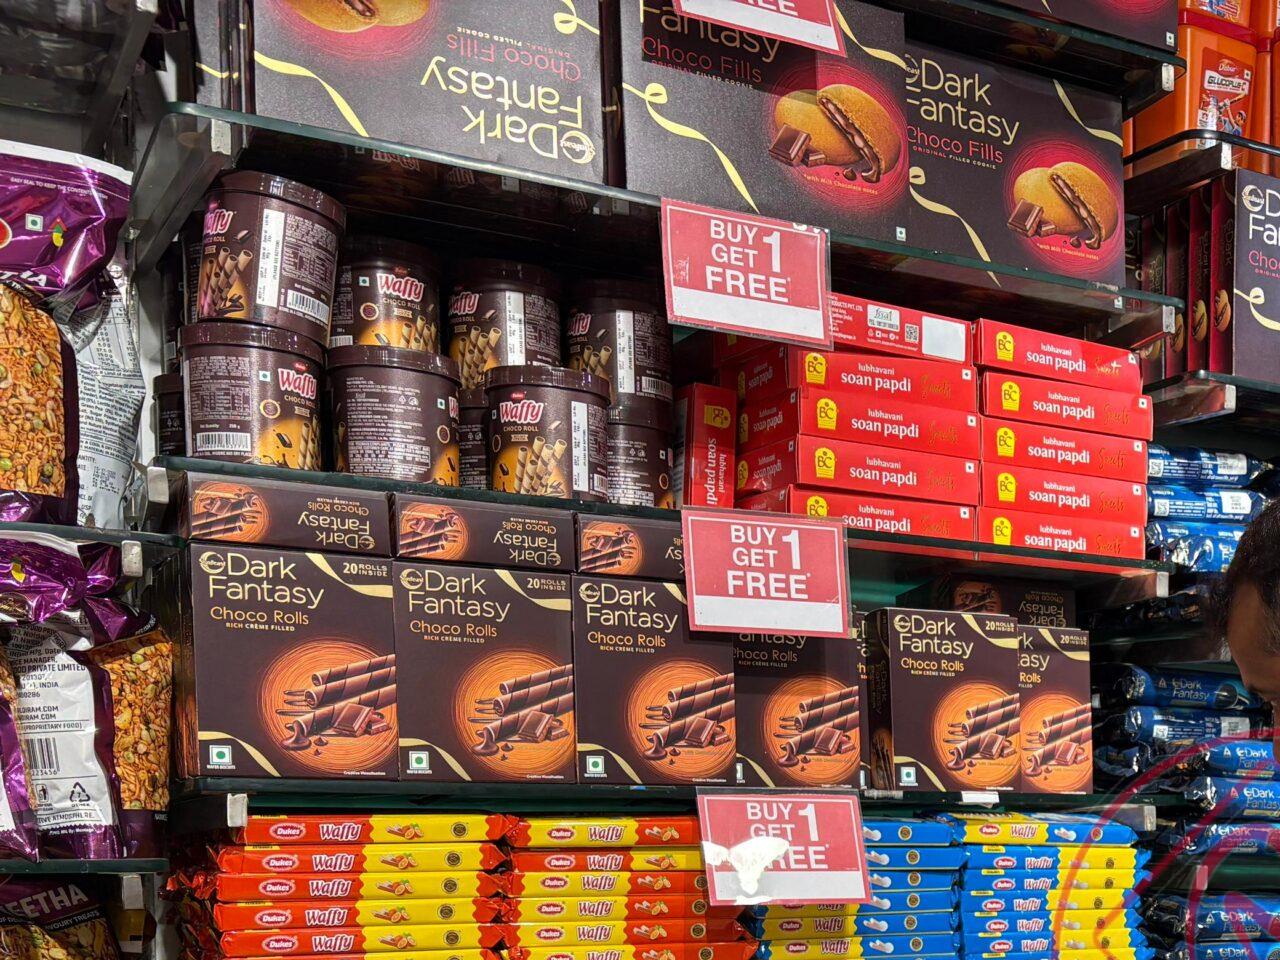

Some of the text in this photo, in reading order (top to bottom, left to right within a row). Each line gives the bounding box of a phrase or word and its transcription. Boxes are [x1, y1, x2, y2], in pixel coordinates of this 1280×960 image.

[448, 34, 580, 81] Choco Fills
[420, 56, 582, 129] Fantasy
[921, 58, 992, 106] Dark
[462, 105, 558, 159] Dark
[907, 124, 1003, 164] Choco Fills
[710, 220, 758, 244] BUY
[711, 231, 781, 273] GET 1
[377, 273, 424, 301] Waffy
[705, 265, 788, 303] FREE
[1041, 343, 1072, 357] lubhavani
[858, 362, 895, 376] lubhavani
[1026, 350, 1086, 373] soan papdi
[841, 372, 911, 392] soan papdi
[500, 400, 543, 424] Waffy
[298, 511, 371, 533] Fantasy
[316, 530, 358, 547] Dark
[730, 525, 777, 545] BUY
[732, 529, 801, 570] GET 1
[228, 553, 296, 580] Dark
[343, 562, 357, 575] 20
[209, 576, 324, 609] Fantasy
[727, 570, 808, 600] FREE
[211, 607, 309, 625] Choco Rolls
[911, 616, 995, 637] Dark 20
[270, 624, 295, 632] FILLED
[900, 634, 973, 658] Fantasy
[901, 658, 964, 672] Choco Rolls
[1253, 788, 1274, 798] Dark
[746, 803, 792, 821] BUY
[798, 803, 820, 842] 1
[276, 823, 363, 841] Dukes Waffy
[588, 826, 625, 842] Waffy
[1010, 824, 1038, 839] Waffy
[262, 908, 348, 926] Dukes Waffy
